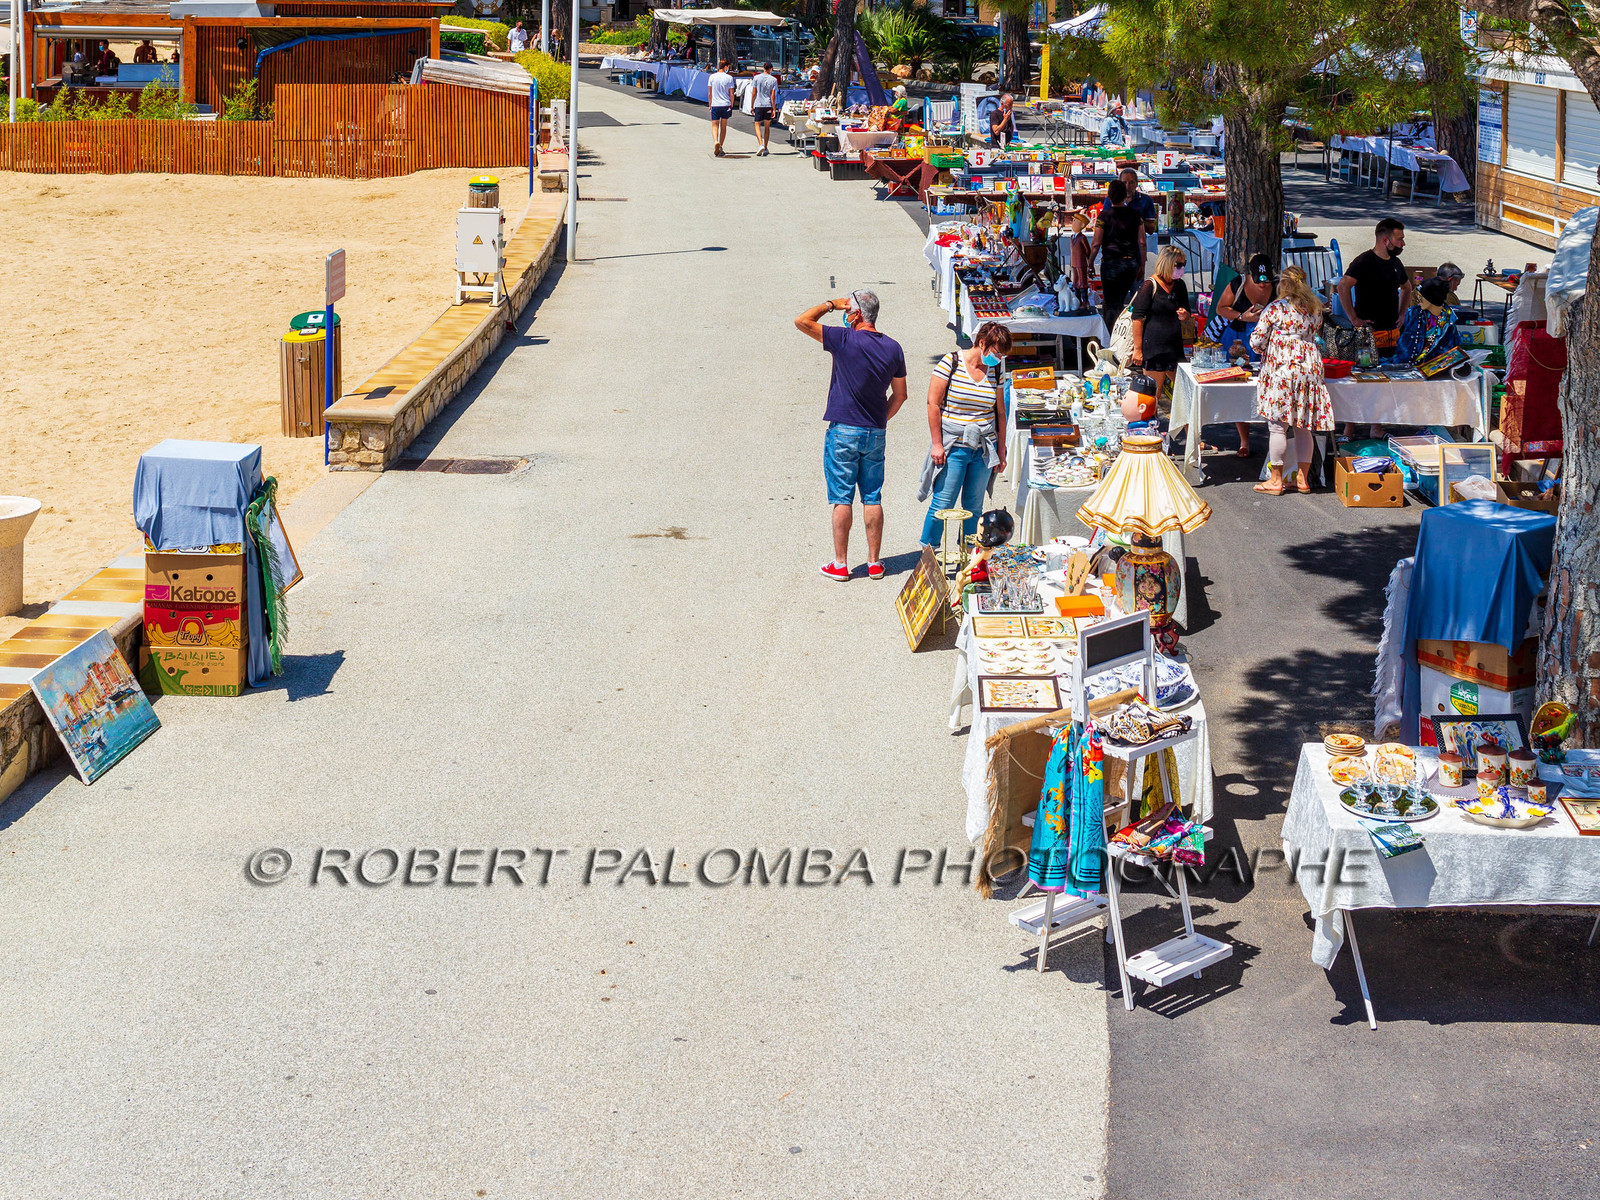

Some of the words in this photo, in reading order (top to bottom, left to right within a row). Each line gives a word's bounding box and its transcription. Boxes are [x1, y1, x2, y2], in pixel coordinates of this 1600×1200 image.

[180, 631, 204, 643] Tropy
[163, 651, 226, 661] BANANES
[1441, 660, 1478, 677] BANANAS
